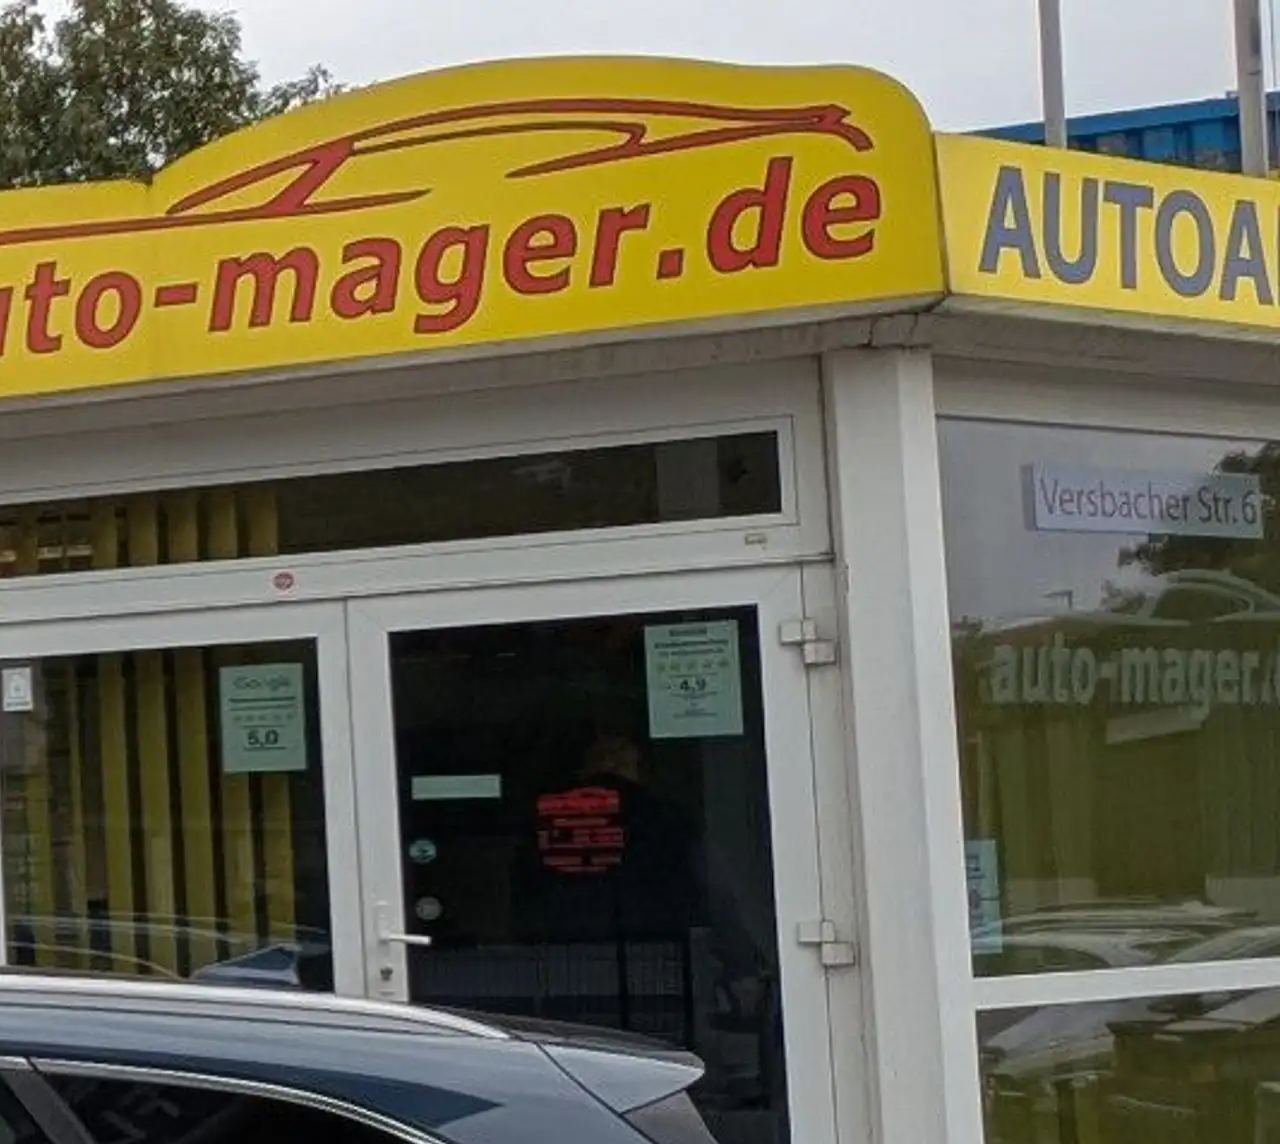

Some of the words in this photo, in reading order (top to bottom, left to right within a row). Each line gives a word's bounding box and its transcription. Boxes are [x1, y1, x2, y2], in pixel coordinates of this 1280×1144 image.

[978, 164, 1280, 306] AUTOA
[1039, 477, 1189, 523] Versbacher
[1196, 486, 1239, 525] Str.
